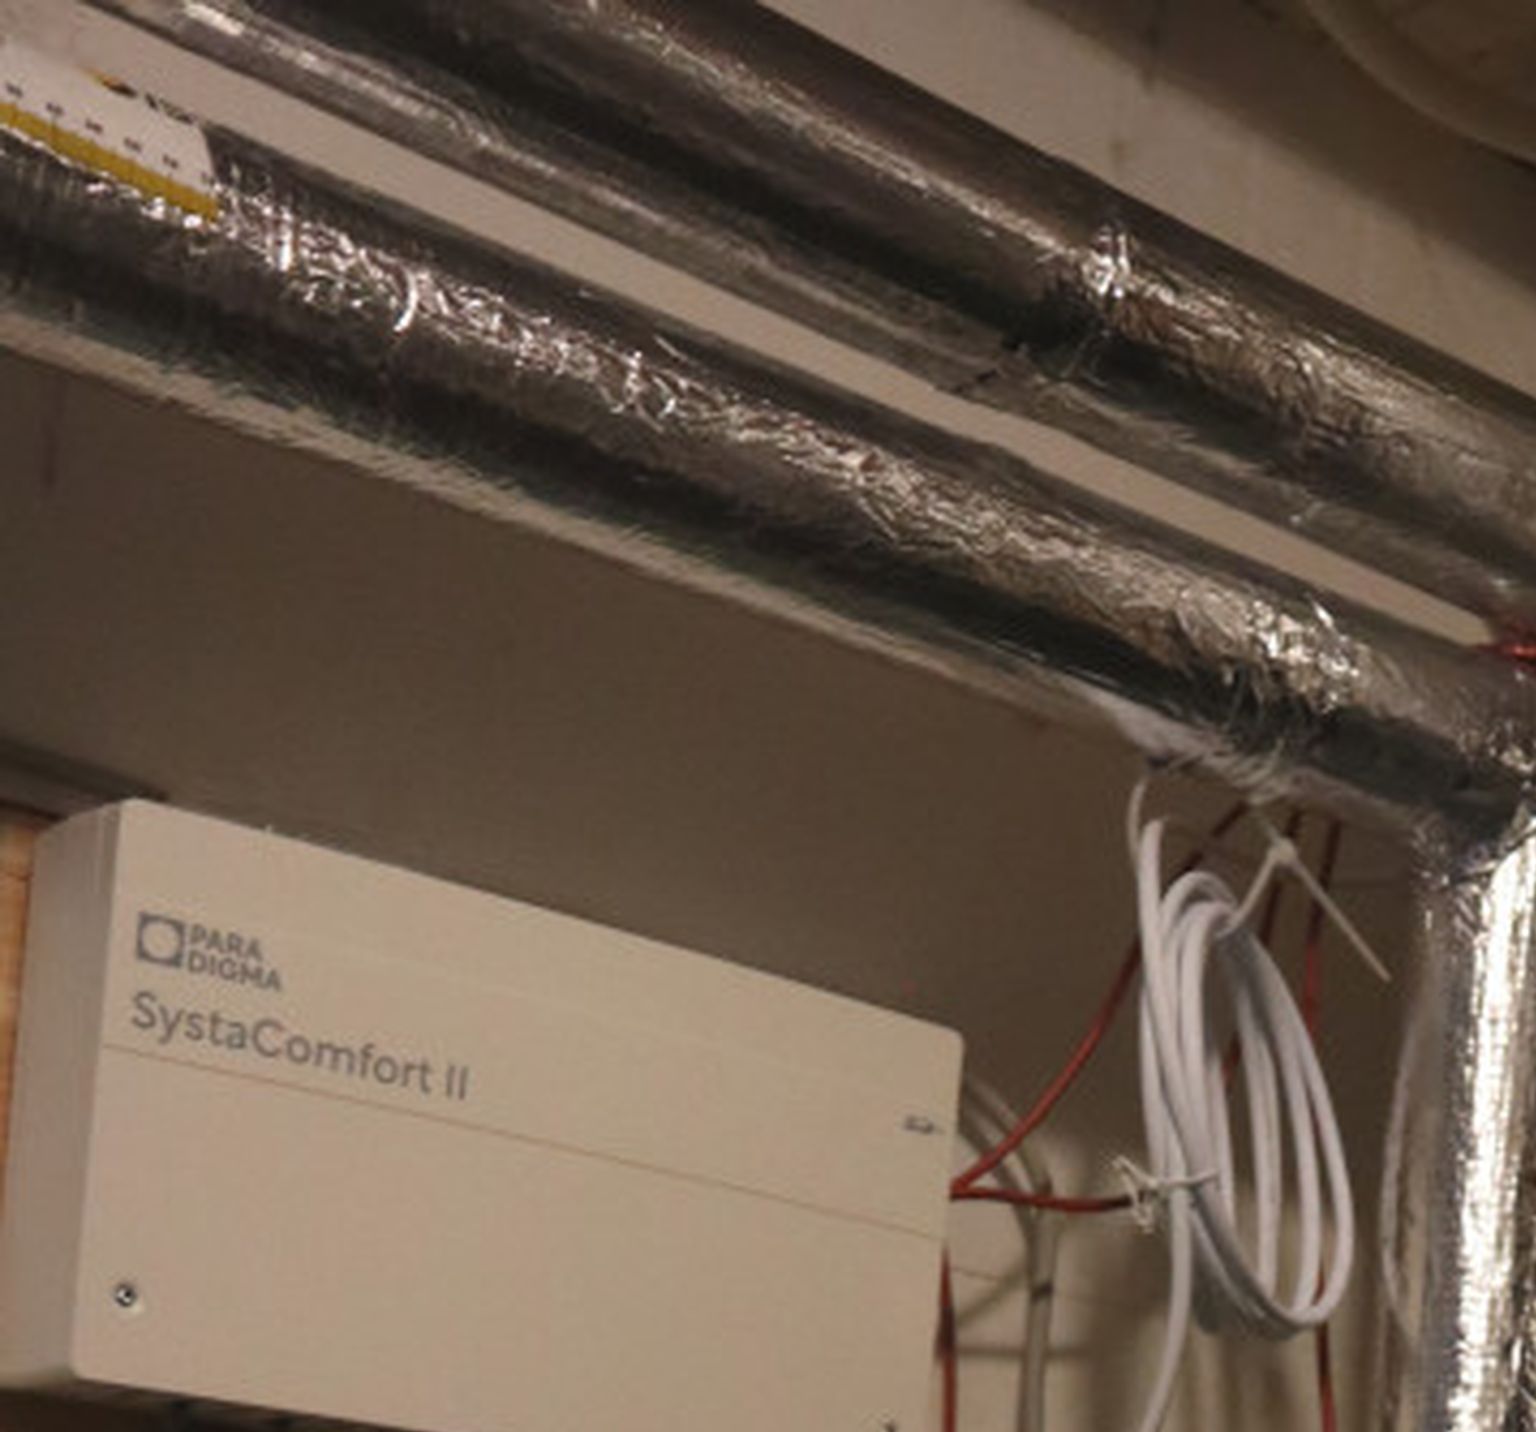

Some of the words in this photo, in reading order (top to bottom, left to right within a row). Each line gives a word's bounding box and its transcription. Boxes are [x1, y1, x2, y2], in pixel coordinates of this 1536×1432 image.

[190, 924, 262, 960] PARA
[188, 950, 281, 990] DIGMA
[131, 992, 432, 1093] SystaComfort
